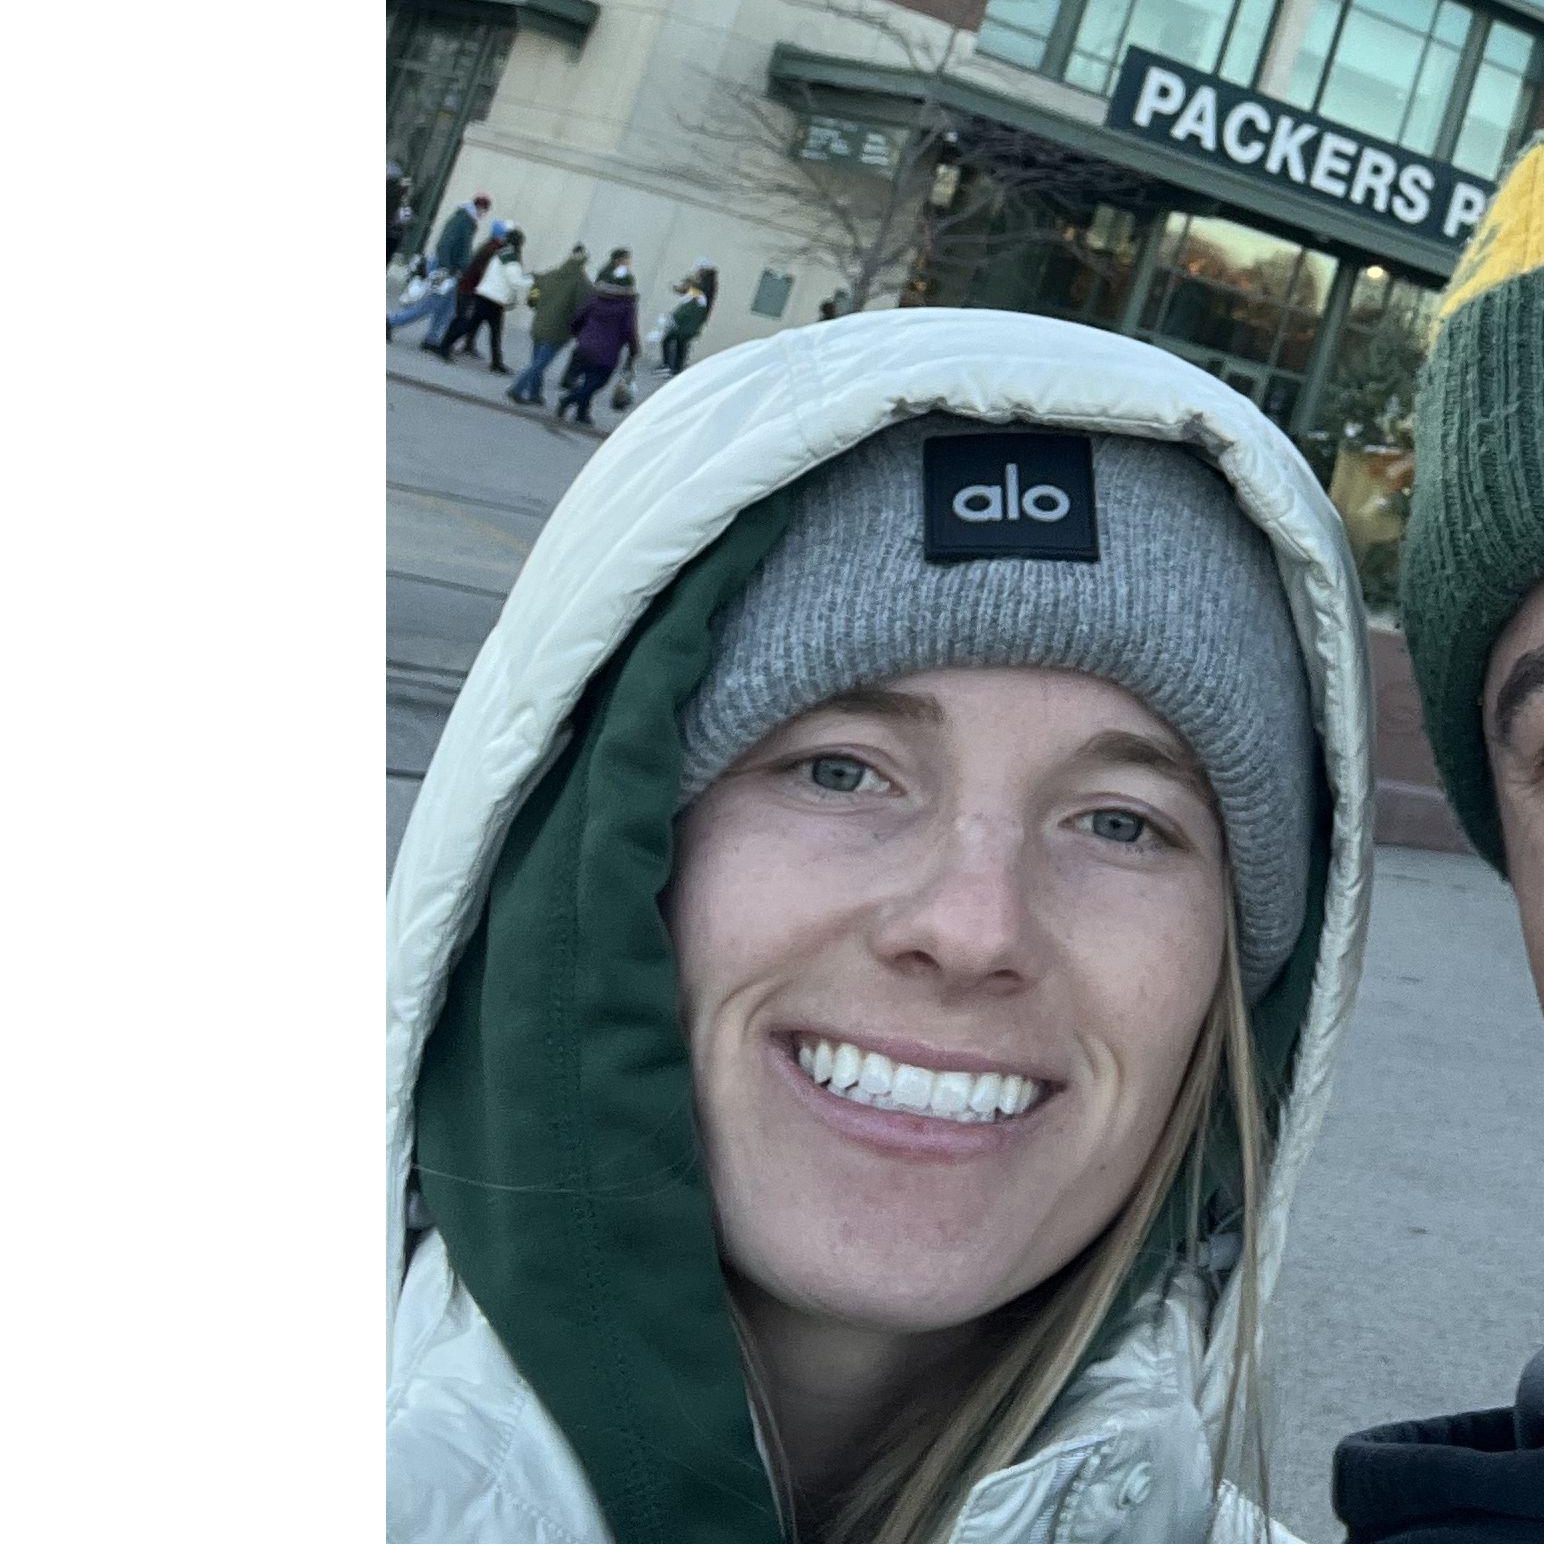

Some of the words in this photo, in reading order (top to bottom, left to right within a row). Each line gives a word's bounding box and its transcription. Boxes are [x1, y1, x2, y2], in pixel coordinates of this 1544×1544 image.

[1132, 65, 1436, 225] PACKERS
[1442, 182, 1489, 239] P
[952, 462, 1071, 523] alo
